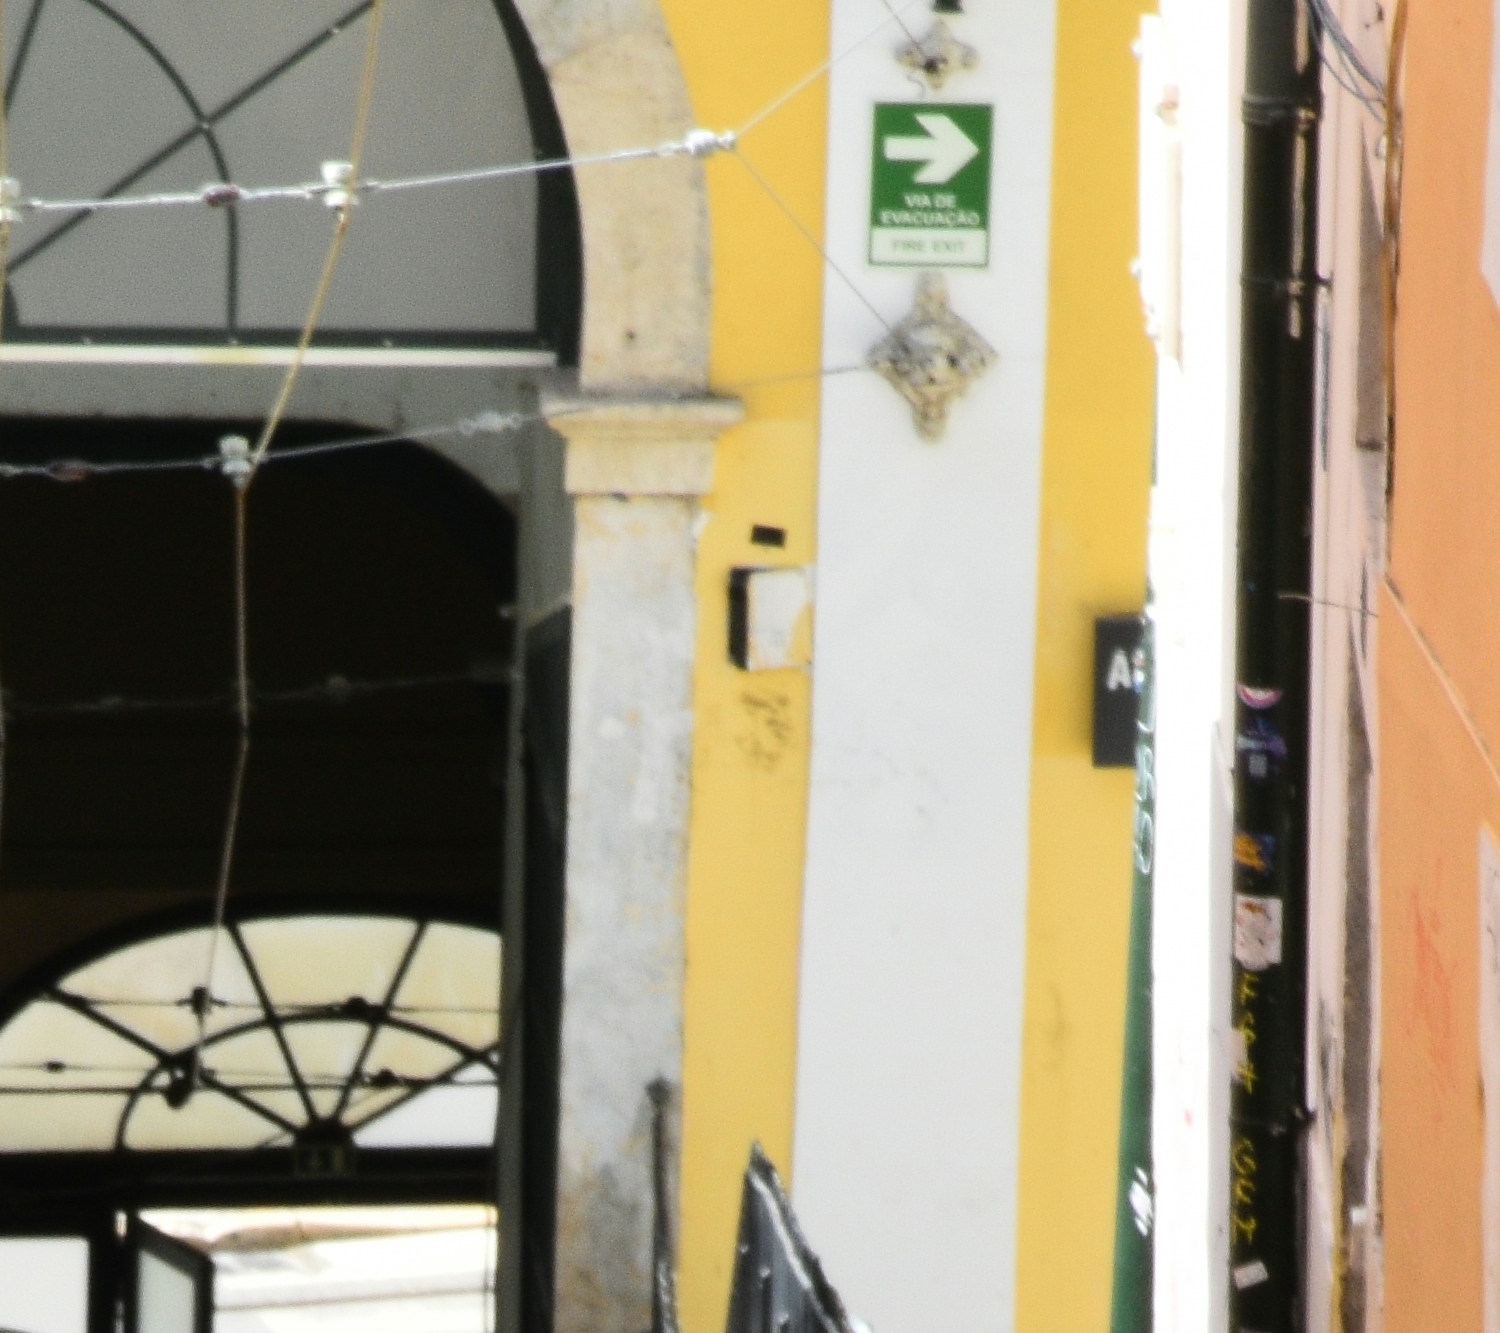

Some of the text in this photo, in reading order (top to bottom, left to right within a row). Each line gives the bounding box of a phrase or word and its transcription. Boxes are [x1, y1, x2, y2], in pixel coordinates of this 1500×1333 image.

[904, 193, 956, 208] VIA DE
[880, 210, 980, 226] EVACUAÇÃO
[892, 240, 964, 253] FIRE EXIT
